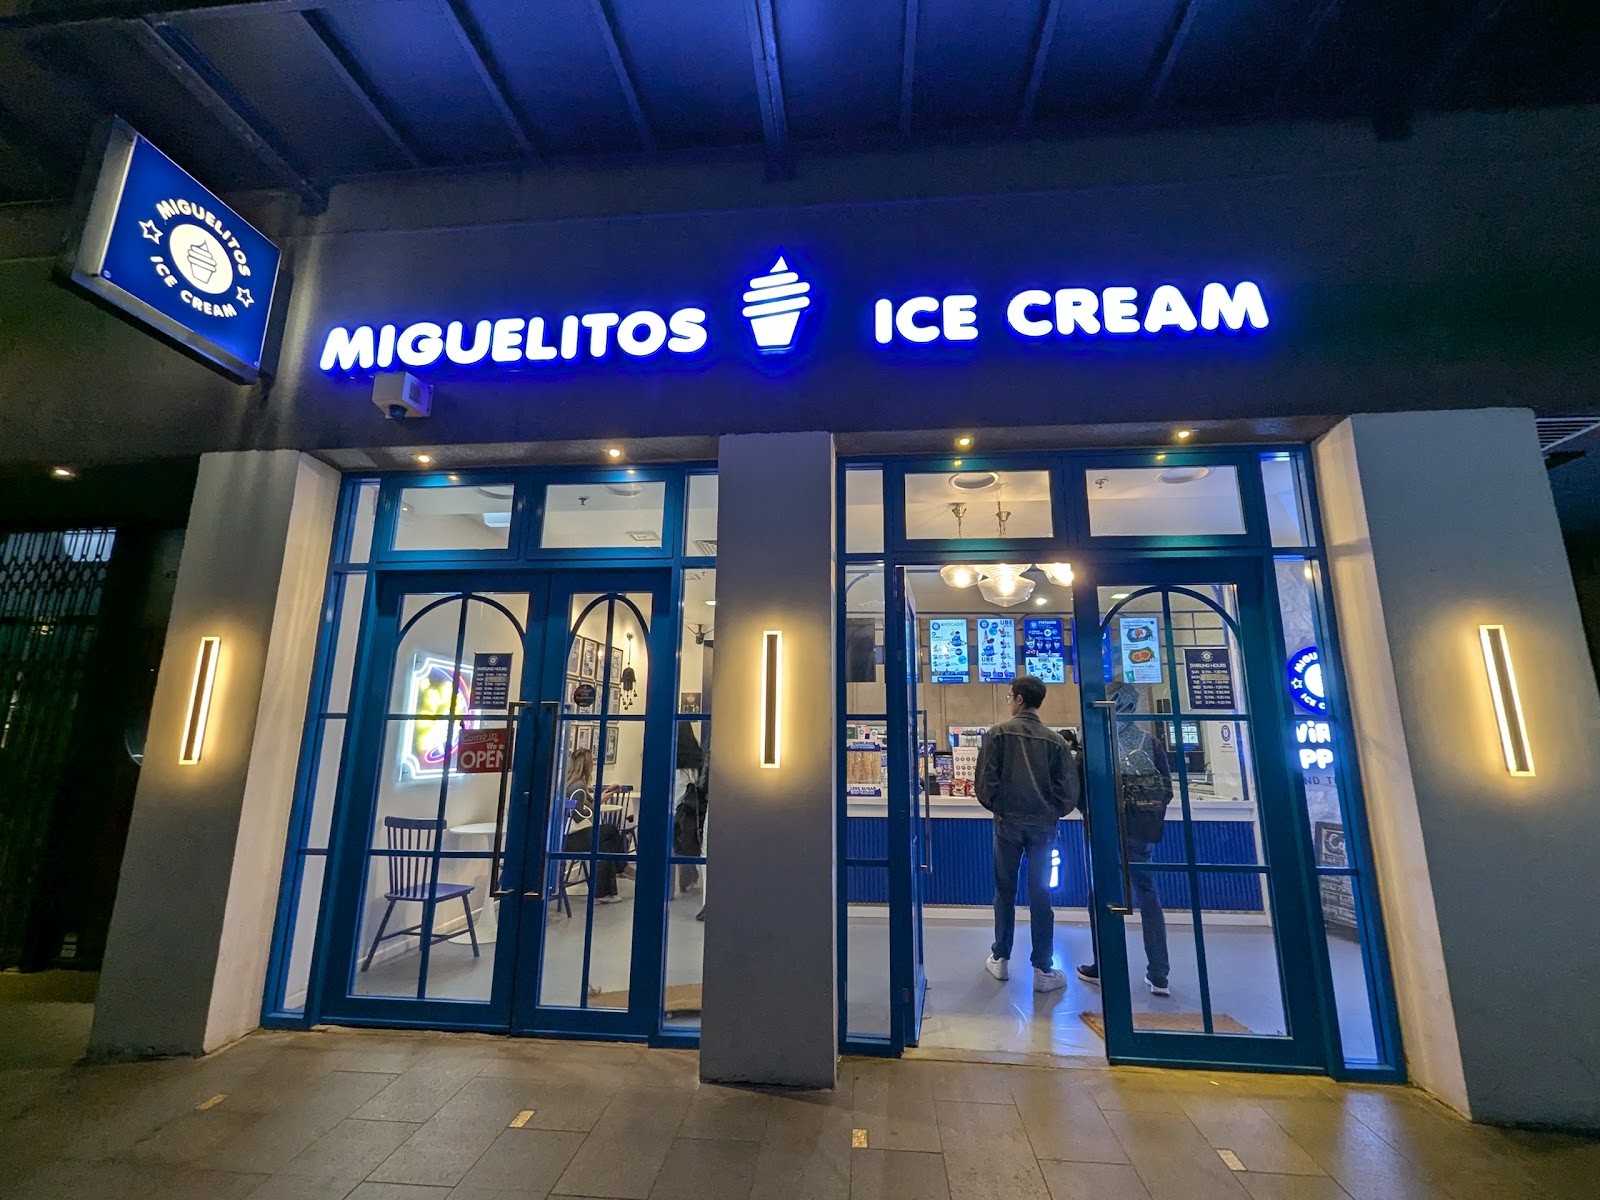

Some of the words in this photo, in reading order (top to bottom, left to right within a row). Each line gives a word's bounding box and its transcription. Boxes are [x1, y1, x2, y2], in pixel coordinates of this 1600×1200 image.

[156, 198, 251, 277] MIGUELITOS
[150, 255, 178, 288] ICE
[180, 289, 237, 318] CREAM
[875, 294, 979, 344] ICE
[1006, 281, 1269, 337] CREAM
[319, 307, 708, 370] MIGUELITOS
[1300, 693, 1317, 707] ICE
[462, 733, 488, 742] Come
